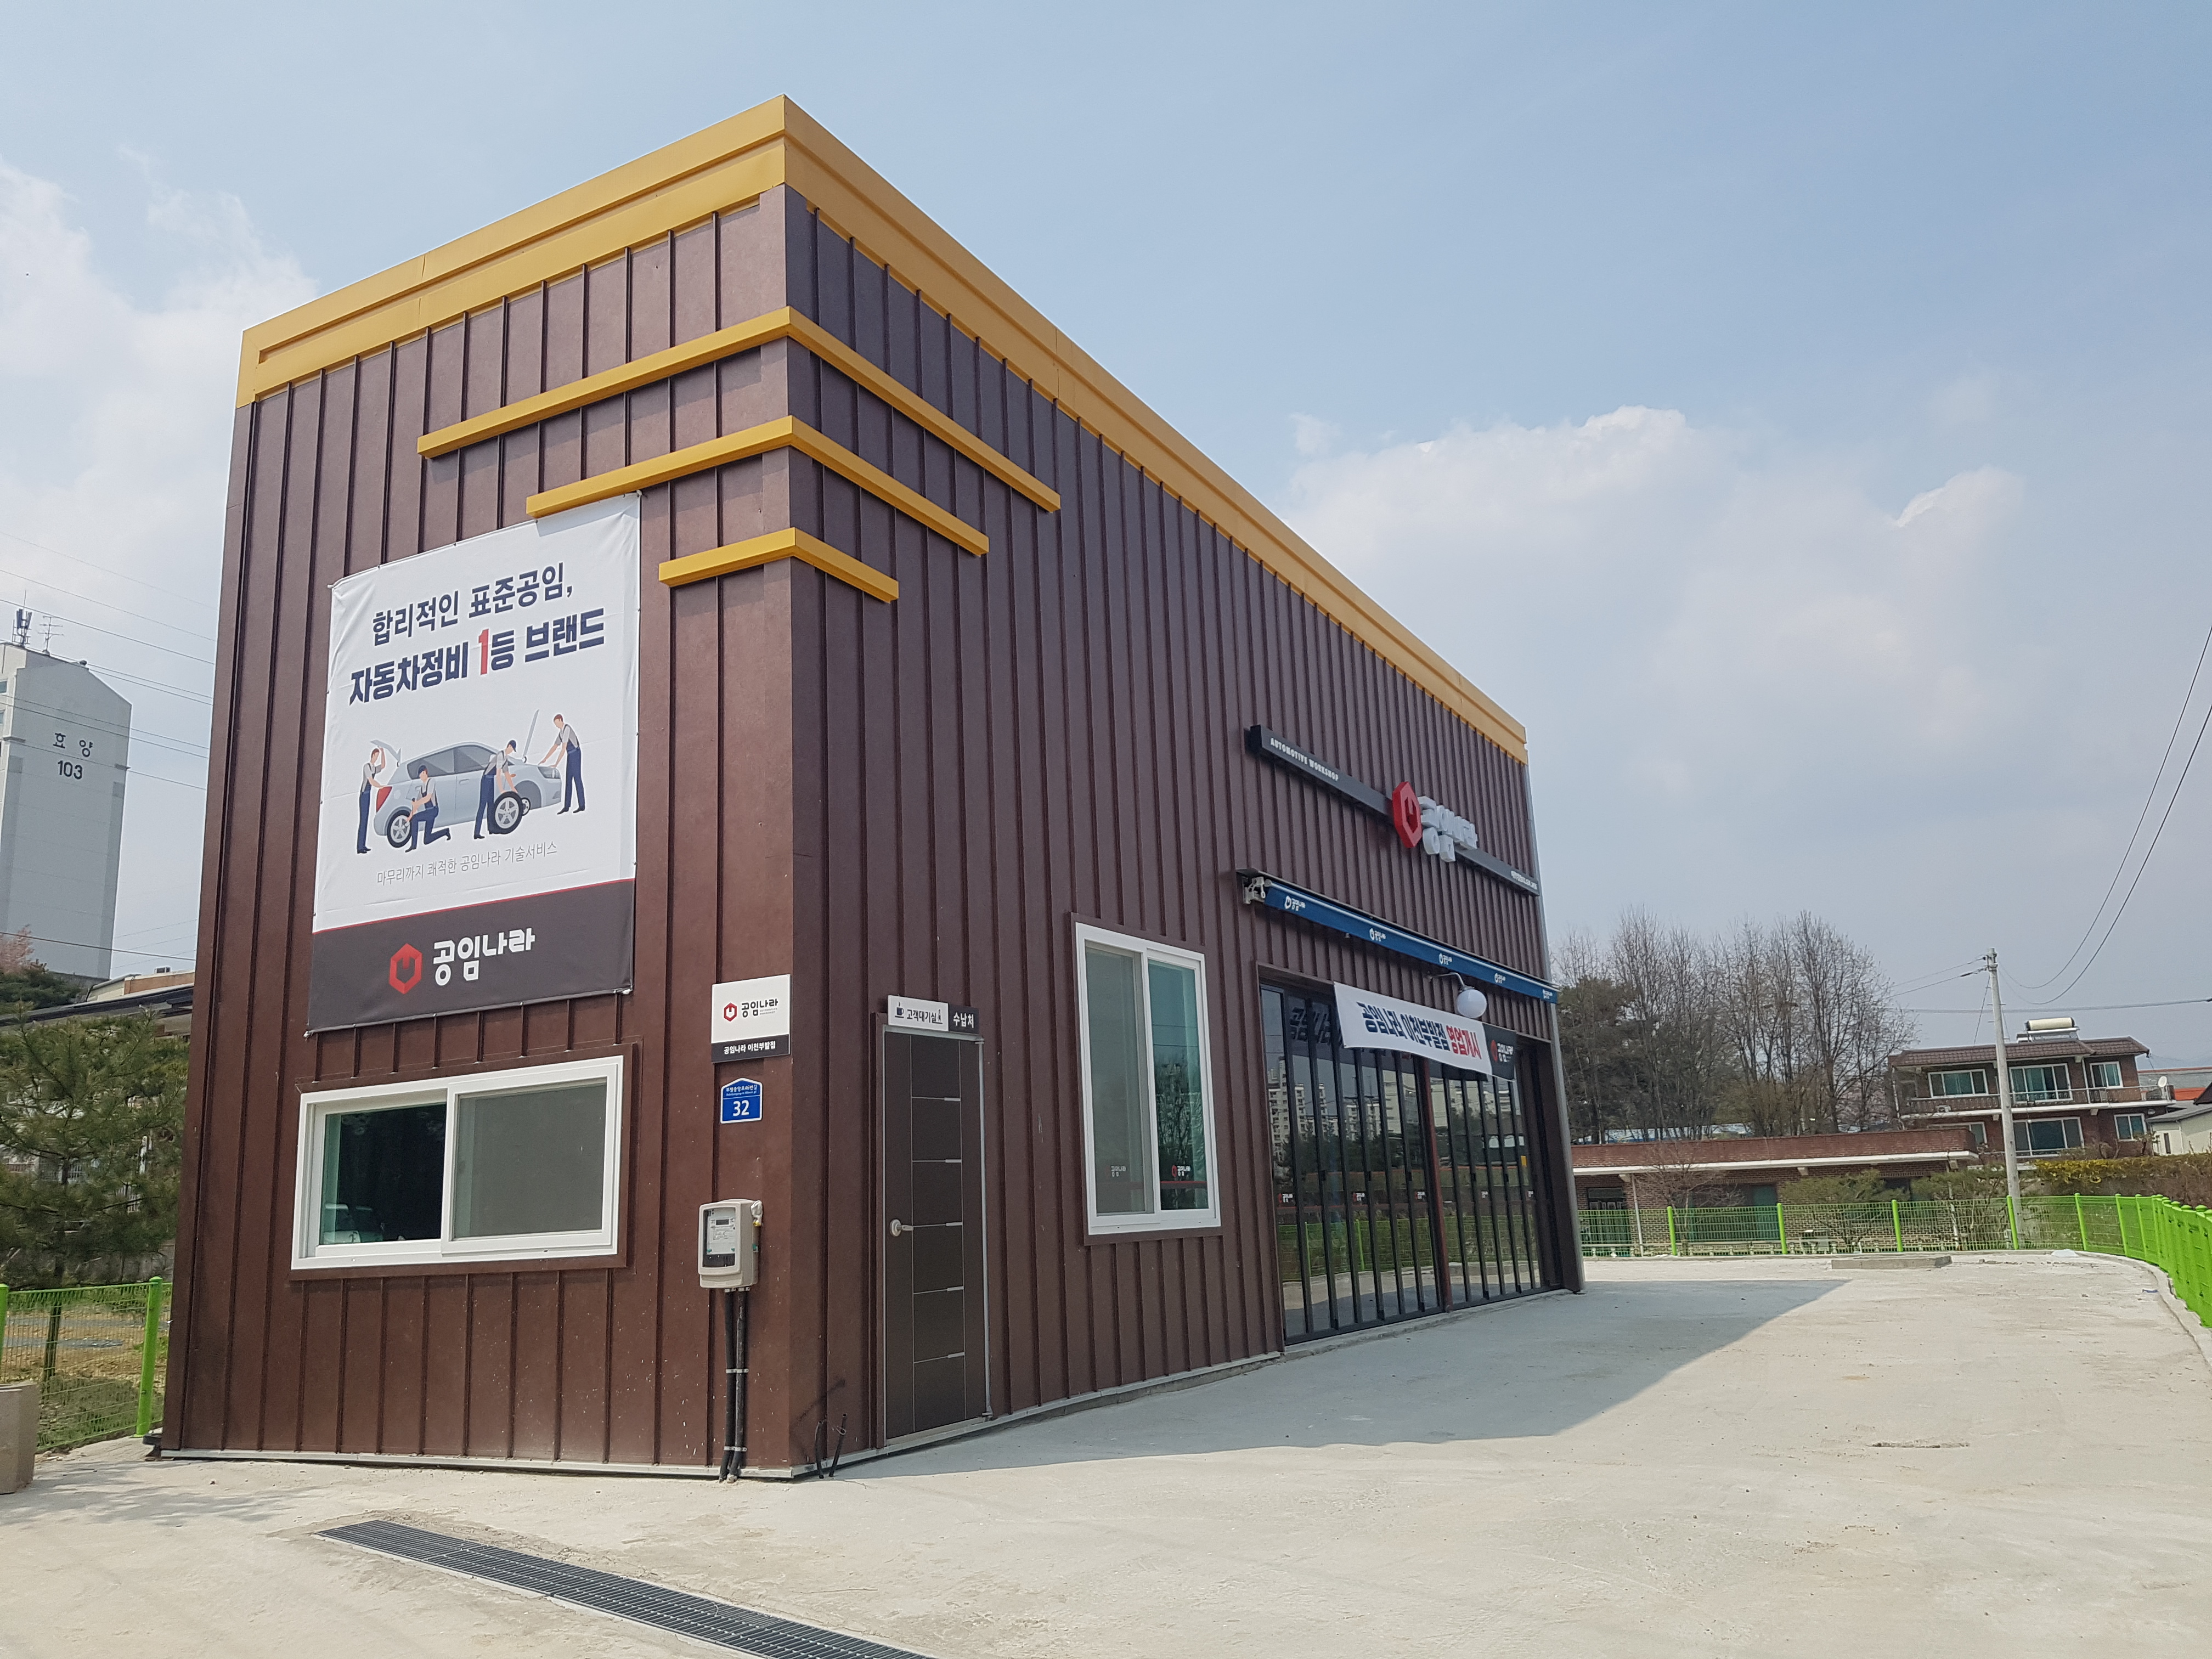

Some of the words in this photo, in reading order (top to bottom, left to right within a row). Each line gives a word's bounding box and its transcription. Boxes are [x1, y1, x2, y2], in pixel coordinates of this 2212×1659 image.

[373, 591, 459, 646] 합리적인
[469, 562, 572, 618] 표준공임,
[349, 641, 469, 706] 자동차정비
[478, 628, 515, 675] 1등
[525, 607, 605, 663] 브랜드
[58, 760, 83, 780] 103
[1271, 737, 1308, 765] AUTOMOTIVE
[1308, 759, 1339, 781] WORKSHOP
[377, 865, 425, 886] 마무리까지
[427, 859, 457, 877] 쾌적한
[460, 851, 501, 872] 공임나라
[505, 841, 558, 864] 기술서비스
[433, 928, 535, 986] 공임나라
[741, 998, 778, 1018] 공임나라
[907, 1009, 936, 1023] 고객대기실
[953, 1012, 974, 1028] 수납처
[1356, 1001, 1408, 1039] 공임나라
[1401, 1014, 1451, 1051] 이천부발점
[1446, 1025, 1482, 1059] 영업개시
[724, 1044, 746, 1054] 공임나라
[748, 1041, 776, 1051] 이천부발점
[733, 1100, 749, 1116] 32
